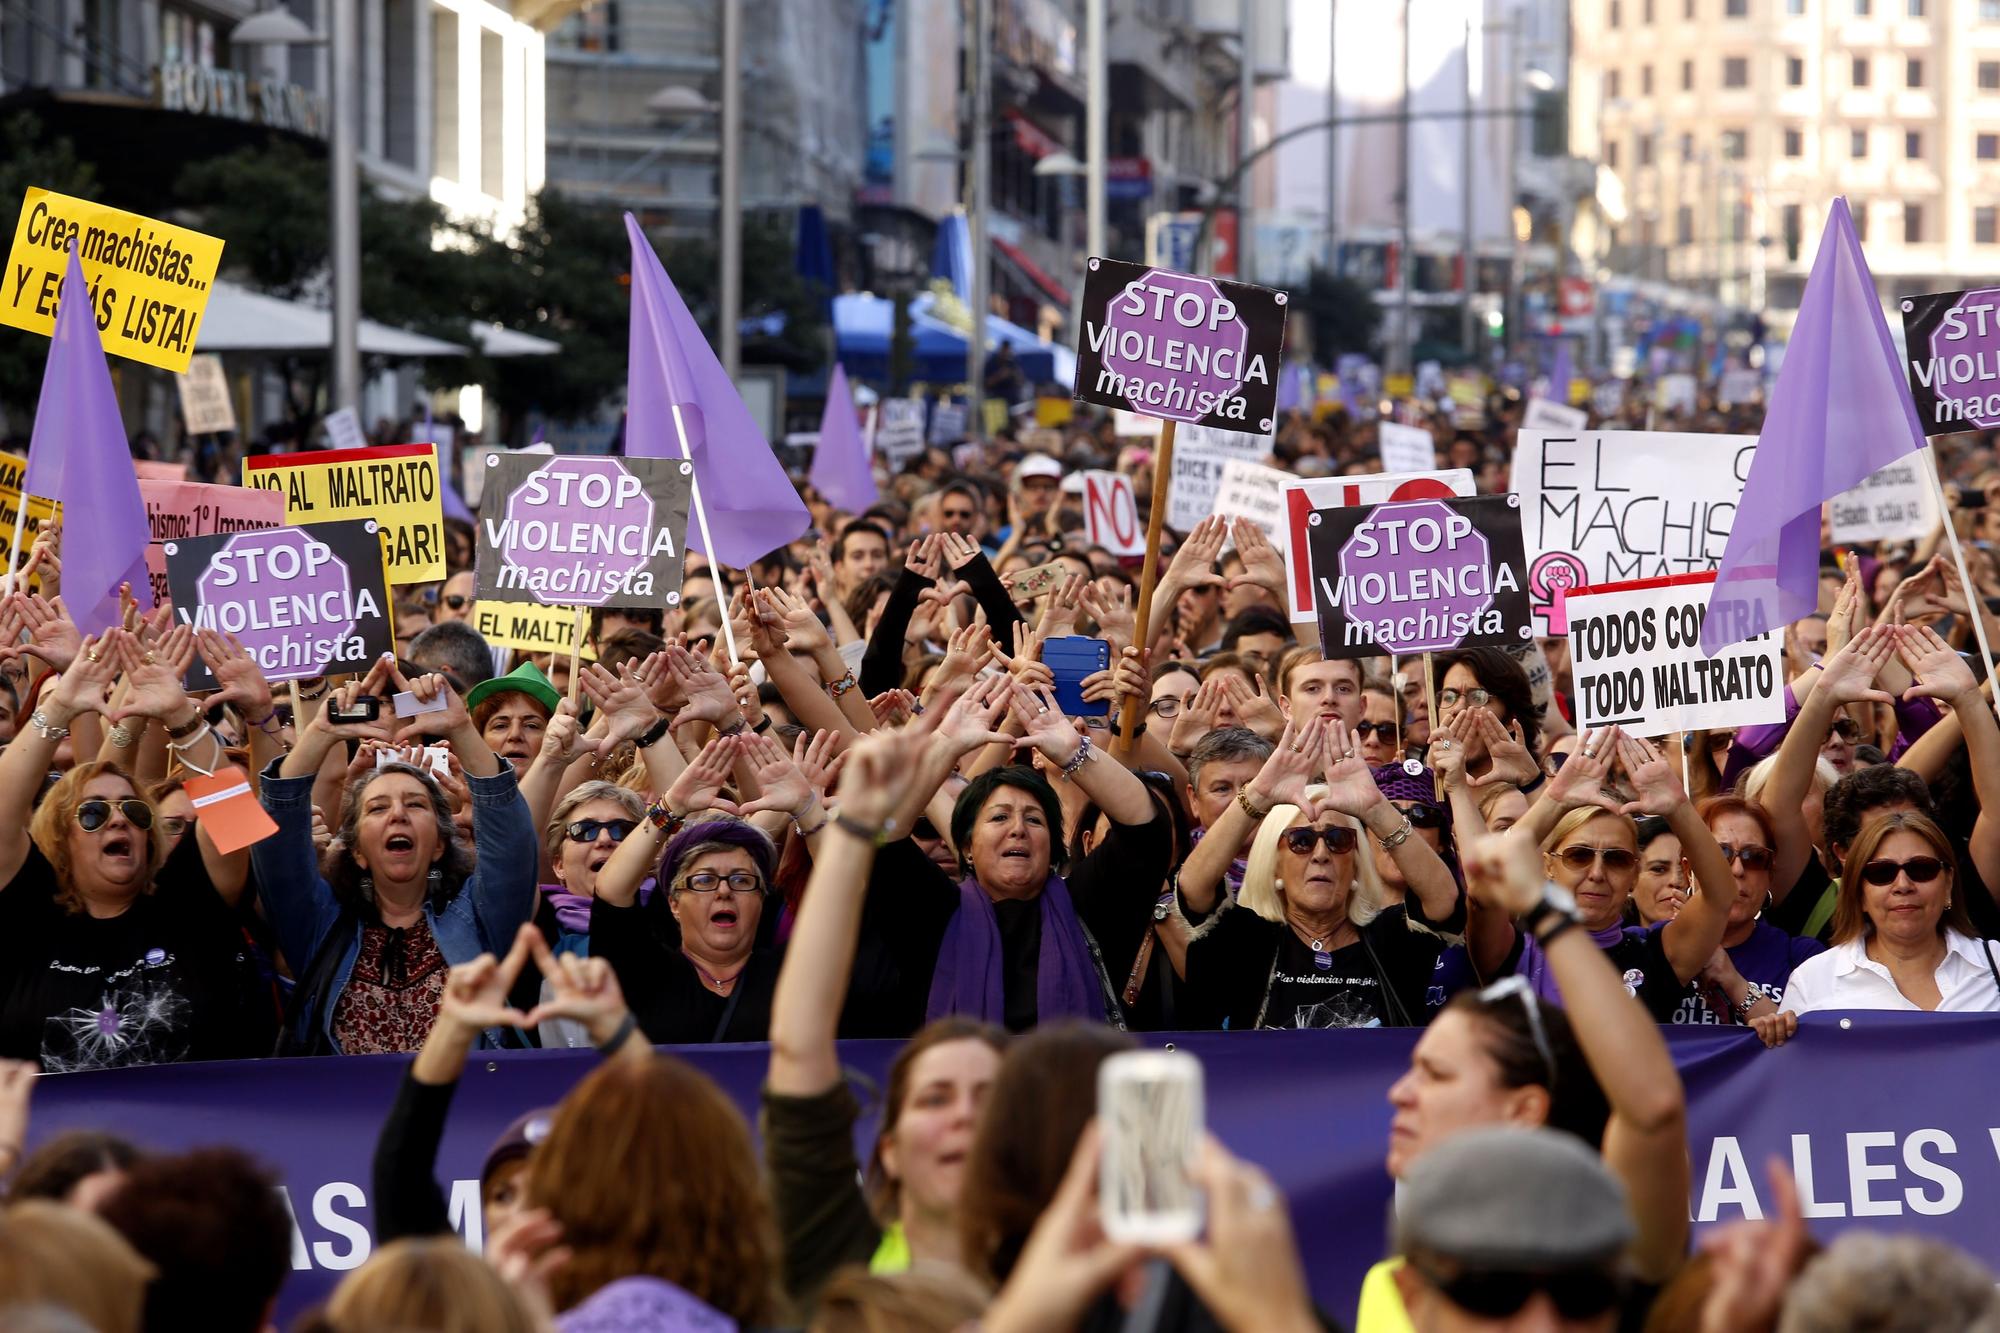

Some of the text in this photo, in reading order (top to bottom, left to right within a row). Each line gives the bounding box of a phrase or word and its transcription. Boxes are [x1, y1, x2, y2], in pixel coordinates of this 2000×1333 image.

[27, 202, 79, 253] Crea
[13, 264, 33, 308] Y
[121, 295, 197, 354] LISTA!
[1122, 281, 1236, 332] STOP
[1944, 304, 2000, 341] ST
[1086, 321, 1269, 385] VIOLENCIA
[1912, 350, 2000, 388] VIOL
[1096, 370, 1248, 420] machista
[1936, 393, 2000, 423] mac
[289, 470, 313, 511] AL
[328, 461, 434, 508] MALTRATO
[1541, 438, 1630, 491] EL
[524, 470, 642, 509] STOP
[1086, 478, 1134, 549] NO
[1354, 515, 1472, 558] STOP
[485, 518, 676, 558] VIOLENCIA
[1286, 478, 1458, 612] N
[210, 541, 332, 586] STOP
[496, 561, 654, 596] machista
[1320, 562, 1519, 608] VIOLENCIA
[178, 588, 381, 635] VIOLENCIA
[480, 613, 503, 637] EL
[1344, 606, 1504, 646] machista
[1571, 597, 1770, 663] TODOS CONTRA
[205, 633, 367, 675] chista
[1581, 667, 1645, 719] TODO
[1653, 654, 1773, 709] MALTRATO
[1296, 974, 1343, 985] violencias
[1688, 1136, 1764, 1223] A
[1791, 1128, 1964, 1219] LES
